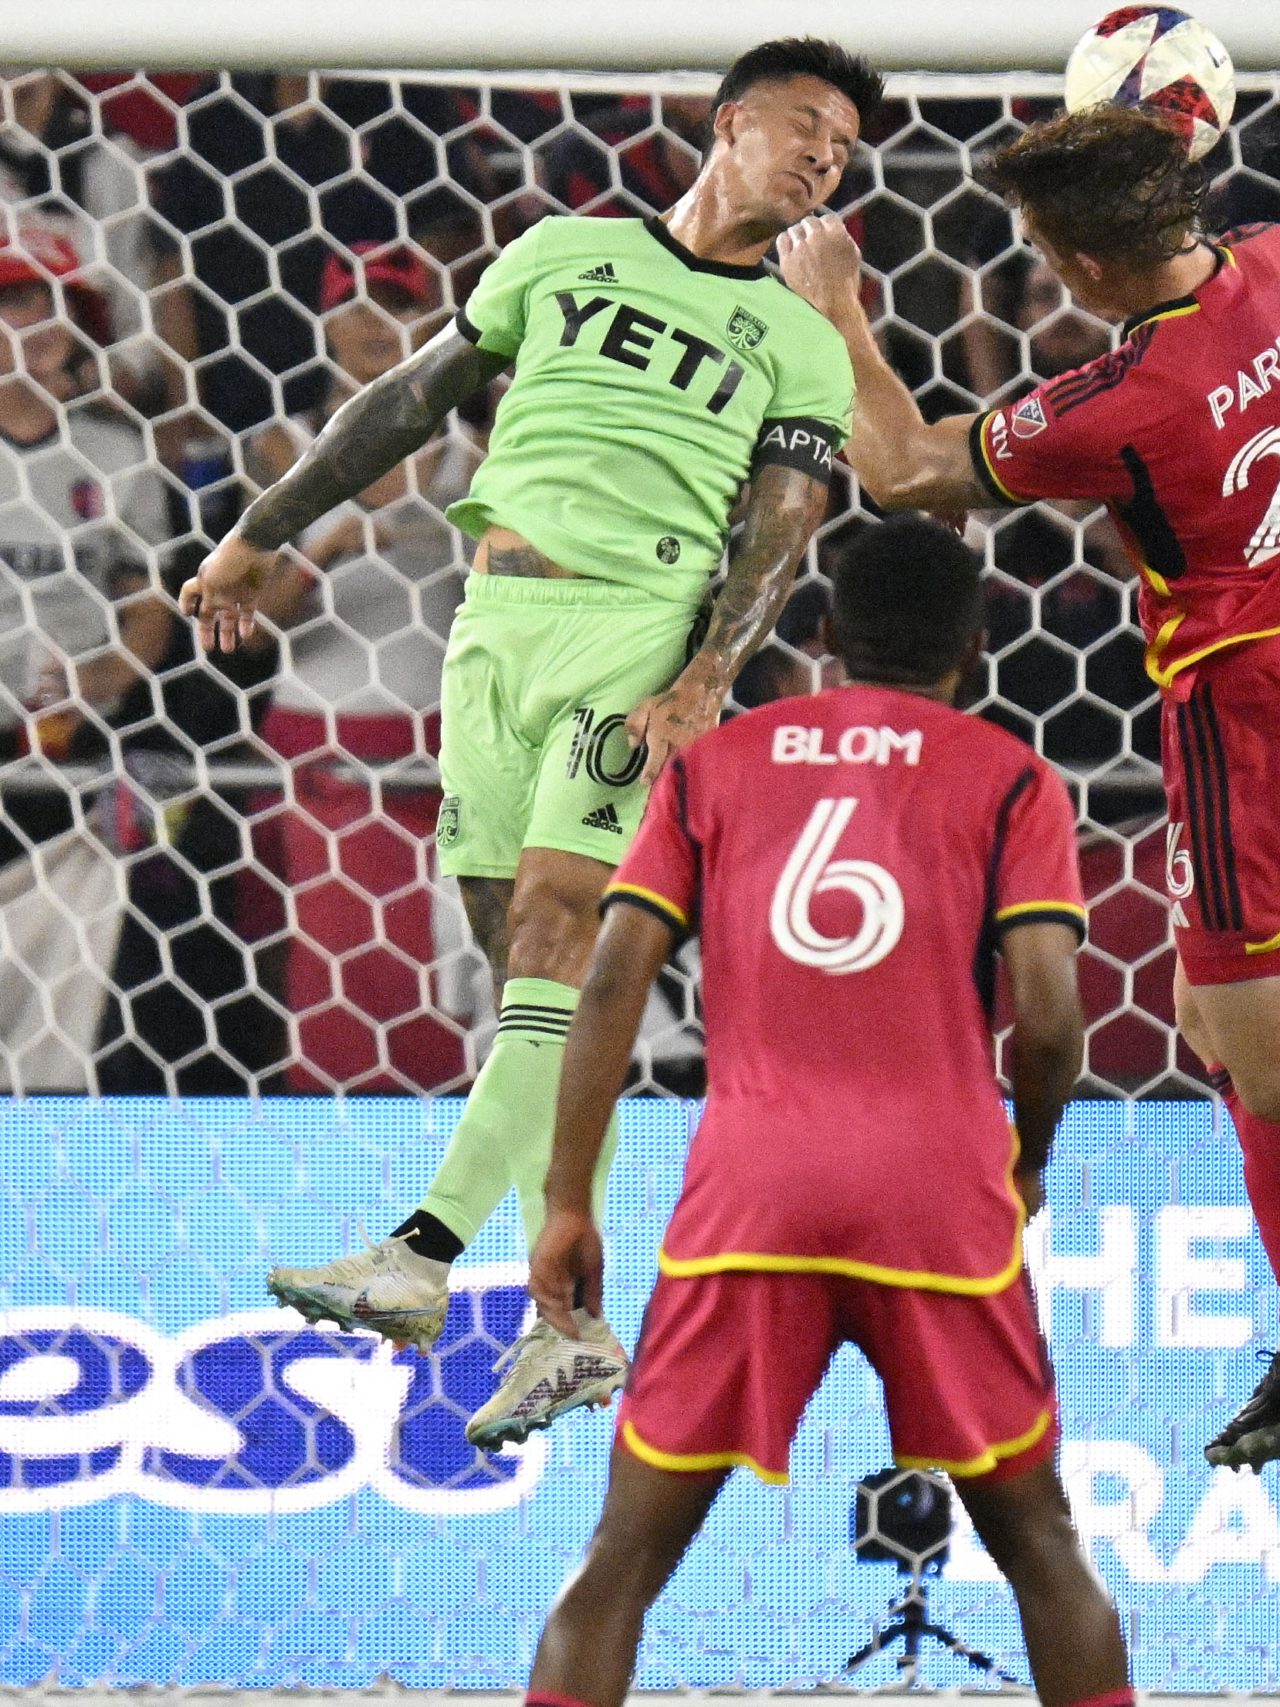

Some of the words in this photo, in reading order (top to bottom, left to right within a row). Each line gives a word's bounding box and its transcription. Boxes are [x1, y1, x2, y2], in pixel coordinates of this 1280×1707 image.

[555, 292, 745, 415] YETI
[761, 425, 832, 471] APTA
[566, 707, 649, 787] 10
[771, 725, 923, 767] BLOM
[581, 817, 623, 835] adidas
[1166, 822, 1195, 899] 6
[769, 797, 906, 976] 6
[1023, 1205, 1256, 1349] HE
